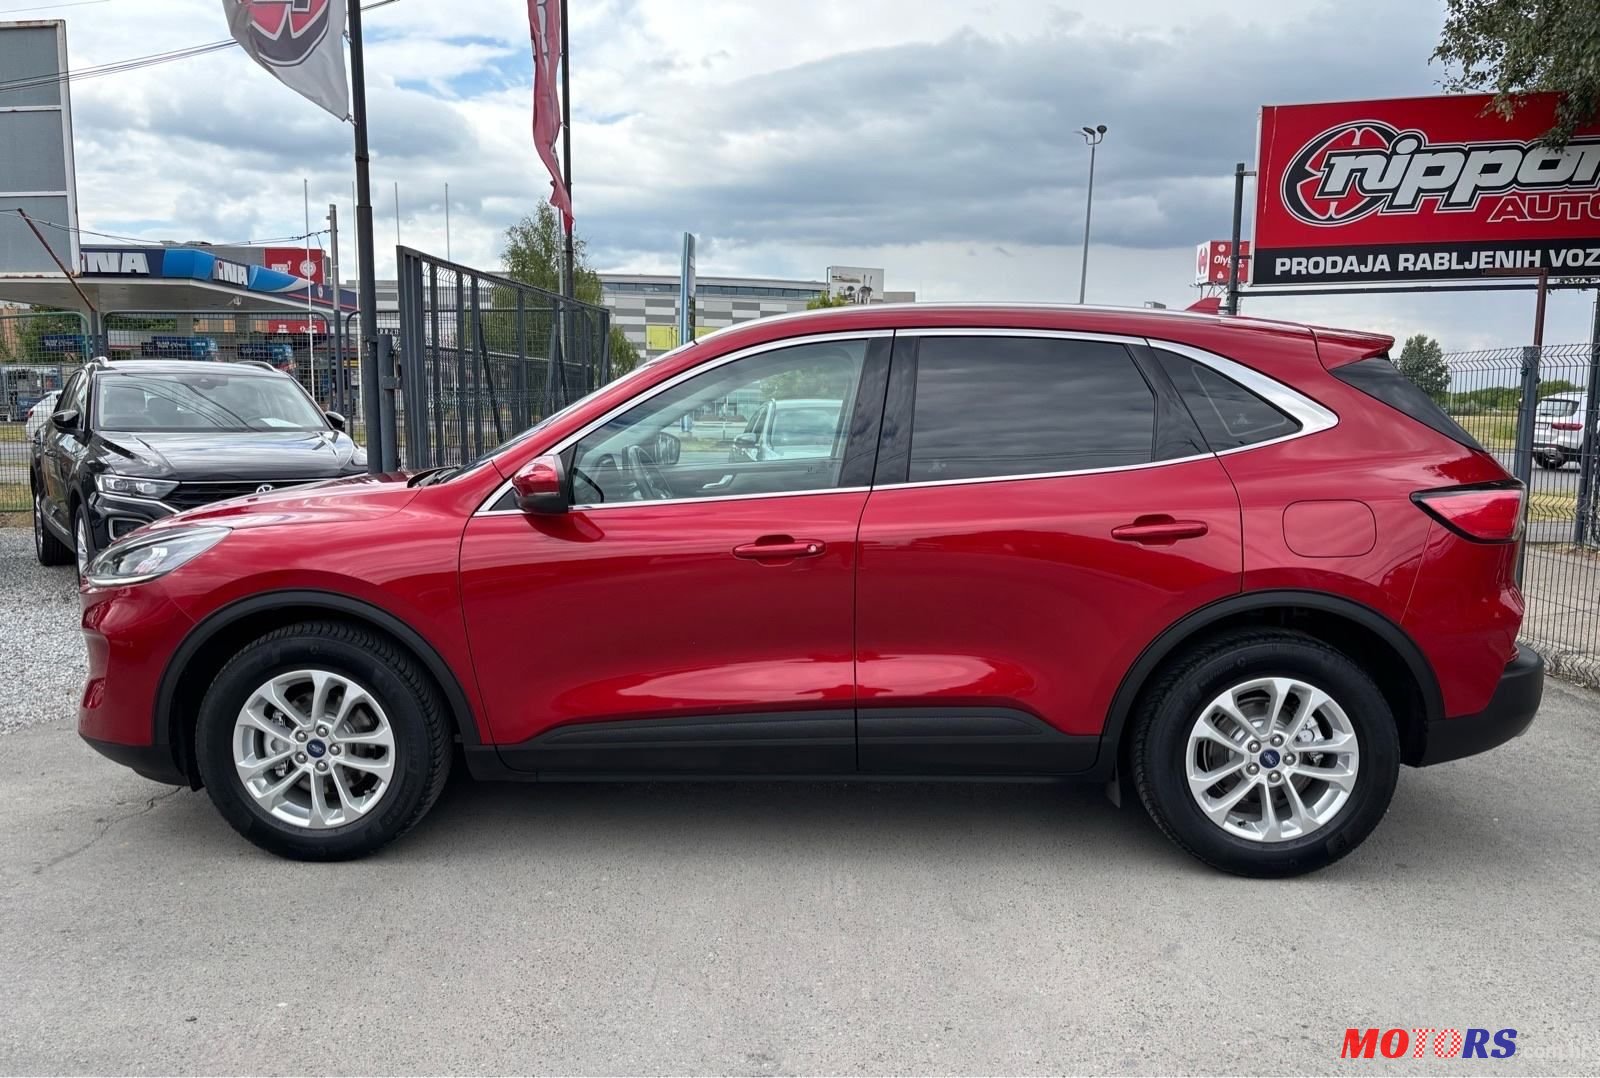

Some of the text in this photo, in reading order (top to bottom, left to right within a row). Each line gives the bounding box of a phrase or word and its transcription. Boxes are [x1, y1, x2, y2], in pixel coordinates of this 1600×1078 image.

[1275, 248, 1600, 276] PRODAJA RABLJENIH VOZ
